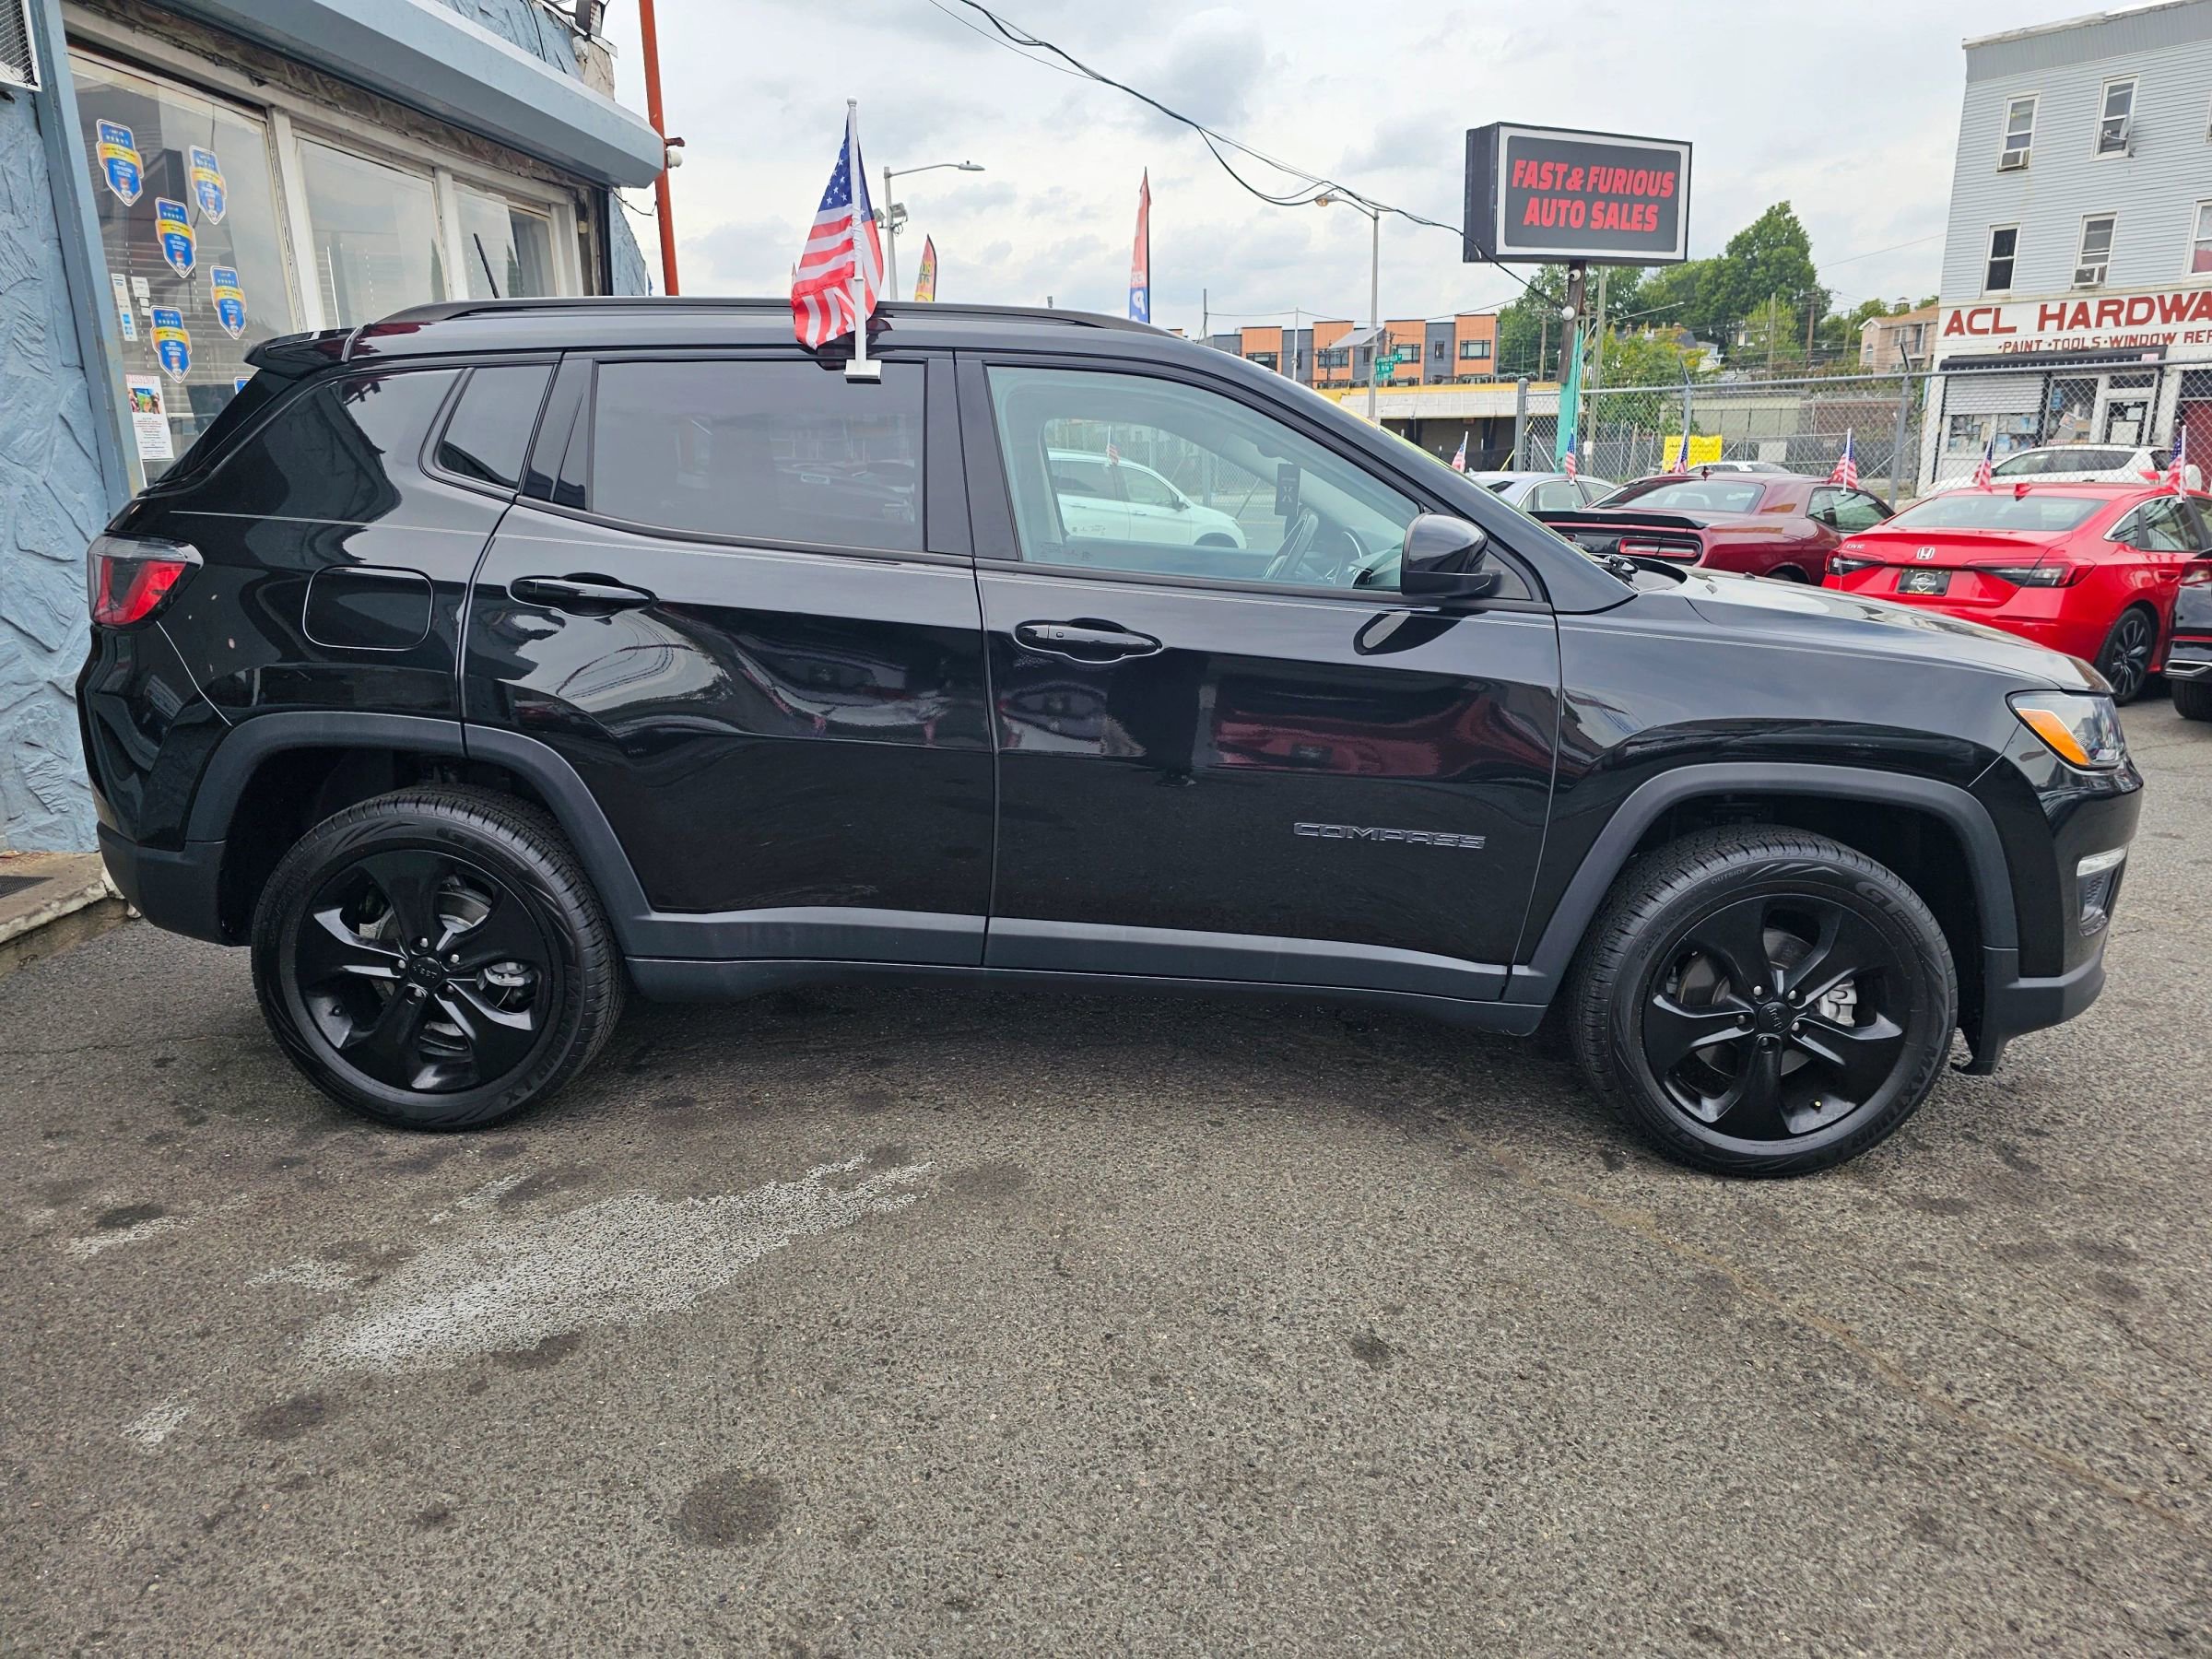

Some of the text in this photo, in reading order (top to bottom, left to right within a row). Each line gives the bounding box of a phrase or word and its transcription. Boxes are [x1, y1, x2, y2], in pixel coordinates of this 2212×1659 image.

[1512, 159, 1676, 199] FAST & FURIOUS
[1523, 196, 1659, 232] AUTO SALES
[1943, 291, 2212, 336] ACL HARDWA
[2002, 339, 2042, 354] PAINT
[2053, 335, 2101, 351] TOOLS
[2109, 331, 2177, 347] WINDOW
[1293, 822, 1486, 850] COMPASS
[1711, 866, 1749, 886] OUTSIDE
[1855, 881, 1902, 915] GT
[1766, 1006, 1783, 1030] Jeep
[1852, 1044, 1938, 1148] MAXTOUR
